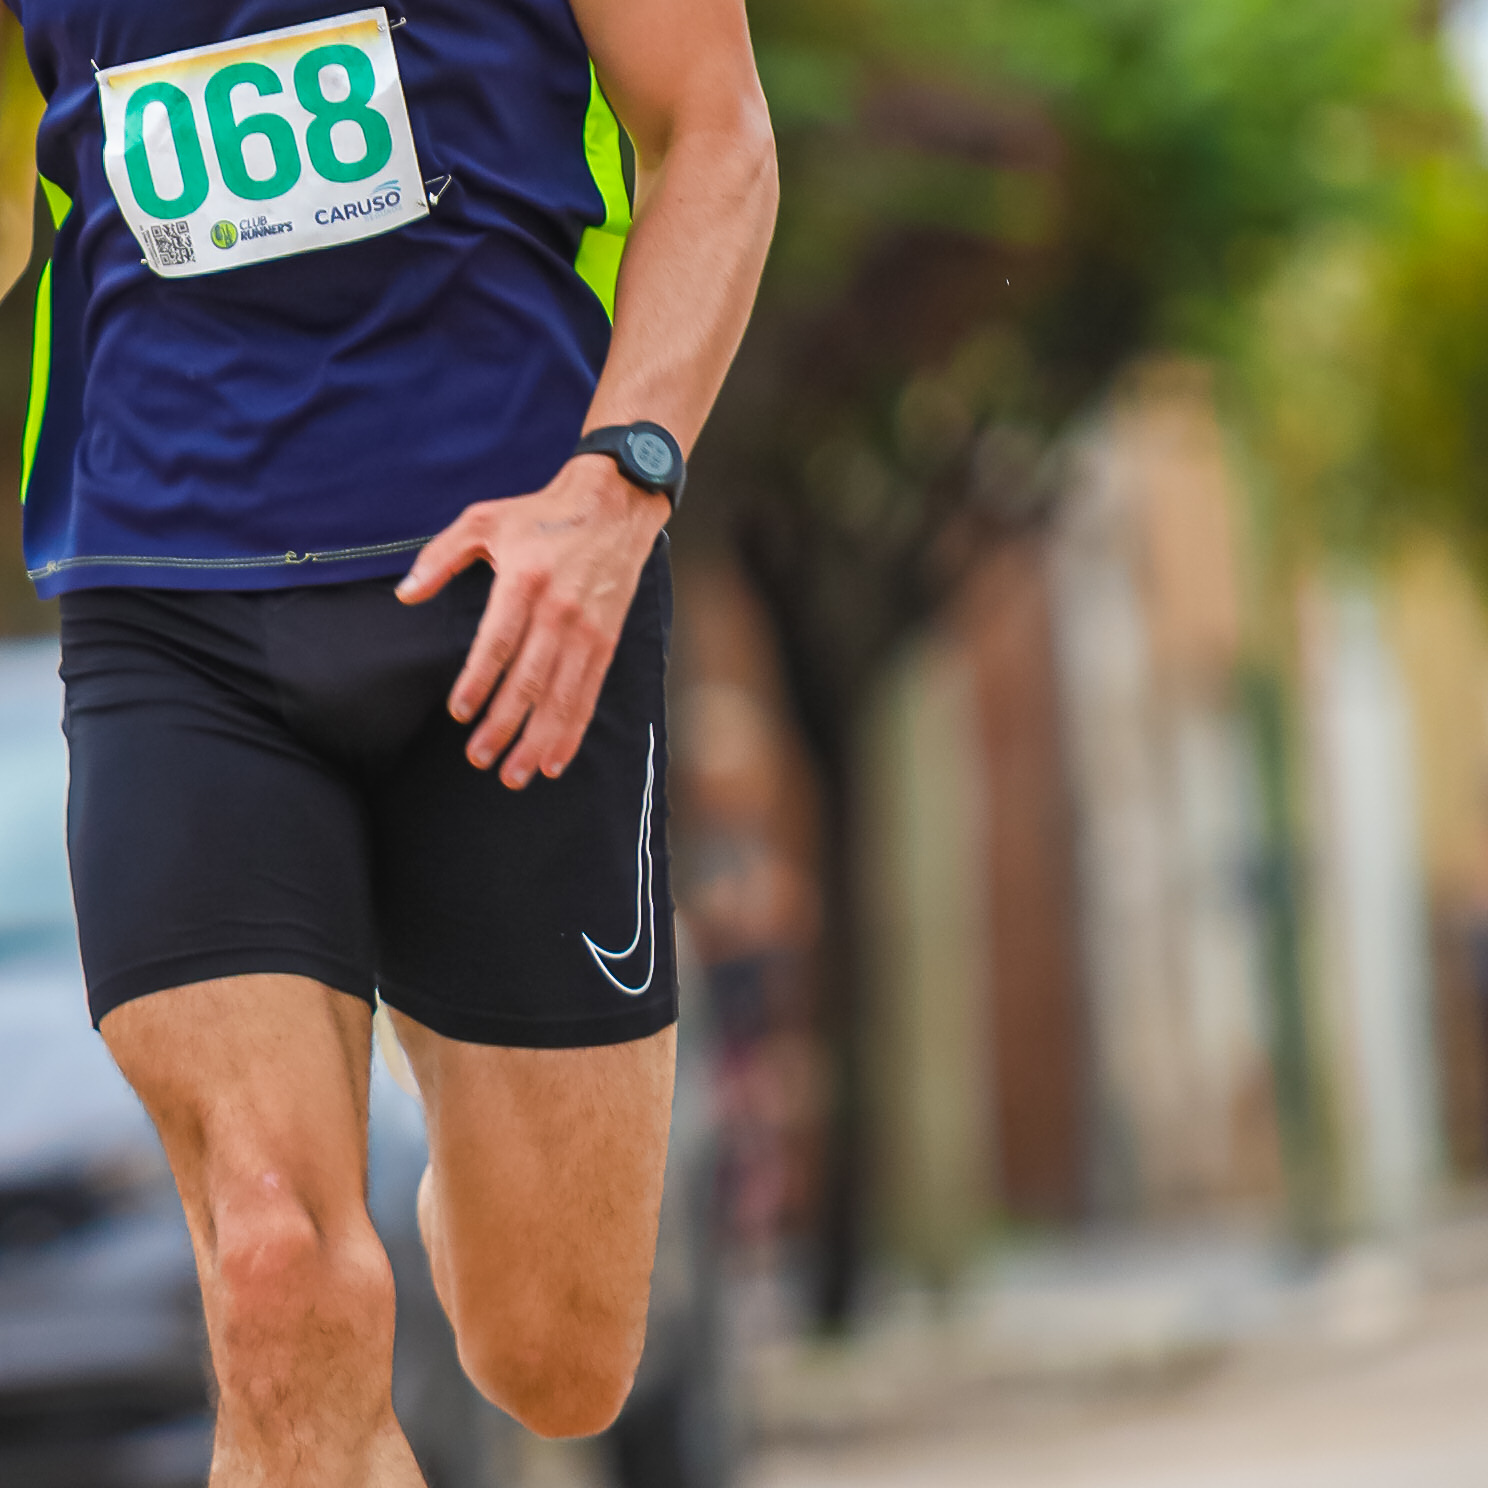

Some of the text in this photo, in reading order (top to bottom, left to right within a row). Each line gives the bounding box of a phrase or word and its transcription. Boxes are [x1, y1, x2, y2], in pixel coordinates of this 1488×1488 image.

[124, 44, 393, 220] 068
[239, 215, 268, 230] CLUB
[315, 191, 401, 225] CARUSO
